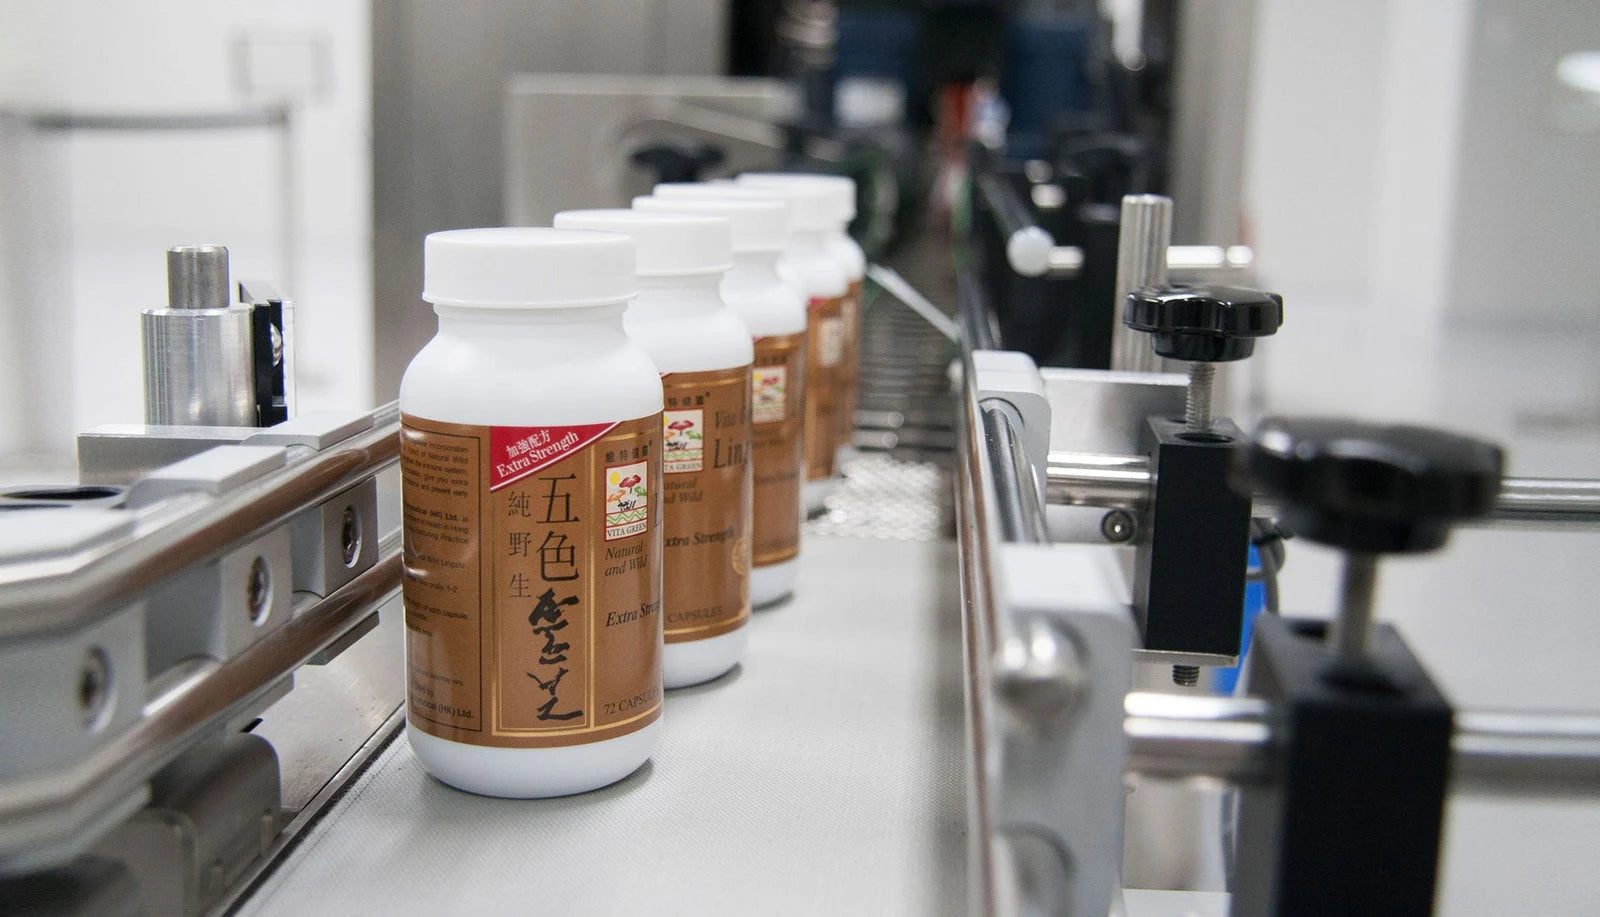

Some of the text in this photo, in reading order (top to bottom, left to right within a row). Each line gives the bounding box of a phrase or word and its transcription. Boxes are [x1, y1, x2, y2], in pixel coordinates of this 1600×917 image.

[506, 430, 550, 458] 加強配方
[496, 431, 579, 478] Extra Strength
[607, 522, 647, 538] VITA GREEN
[508, 490, 531, 599] 純野生
[605, 541, 643, 560] Natural
[664, 536, 690, 548] xtra
[605, 554, 648, 576] and Wild
[606, 610, 638, 627] Extra
[457, 707, 474, 719] Ltd.
[604, 702, 616, 715] 72
